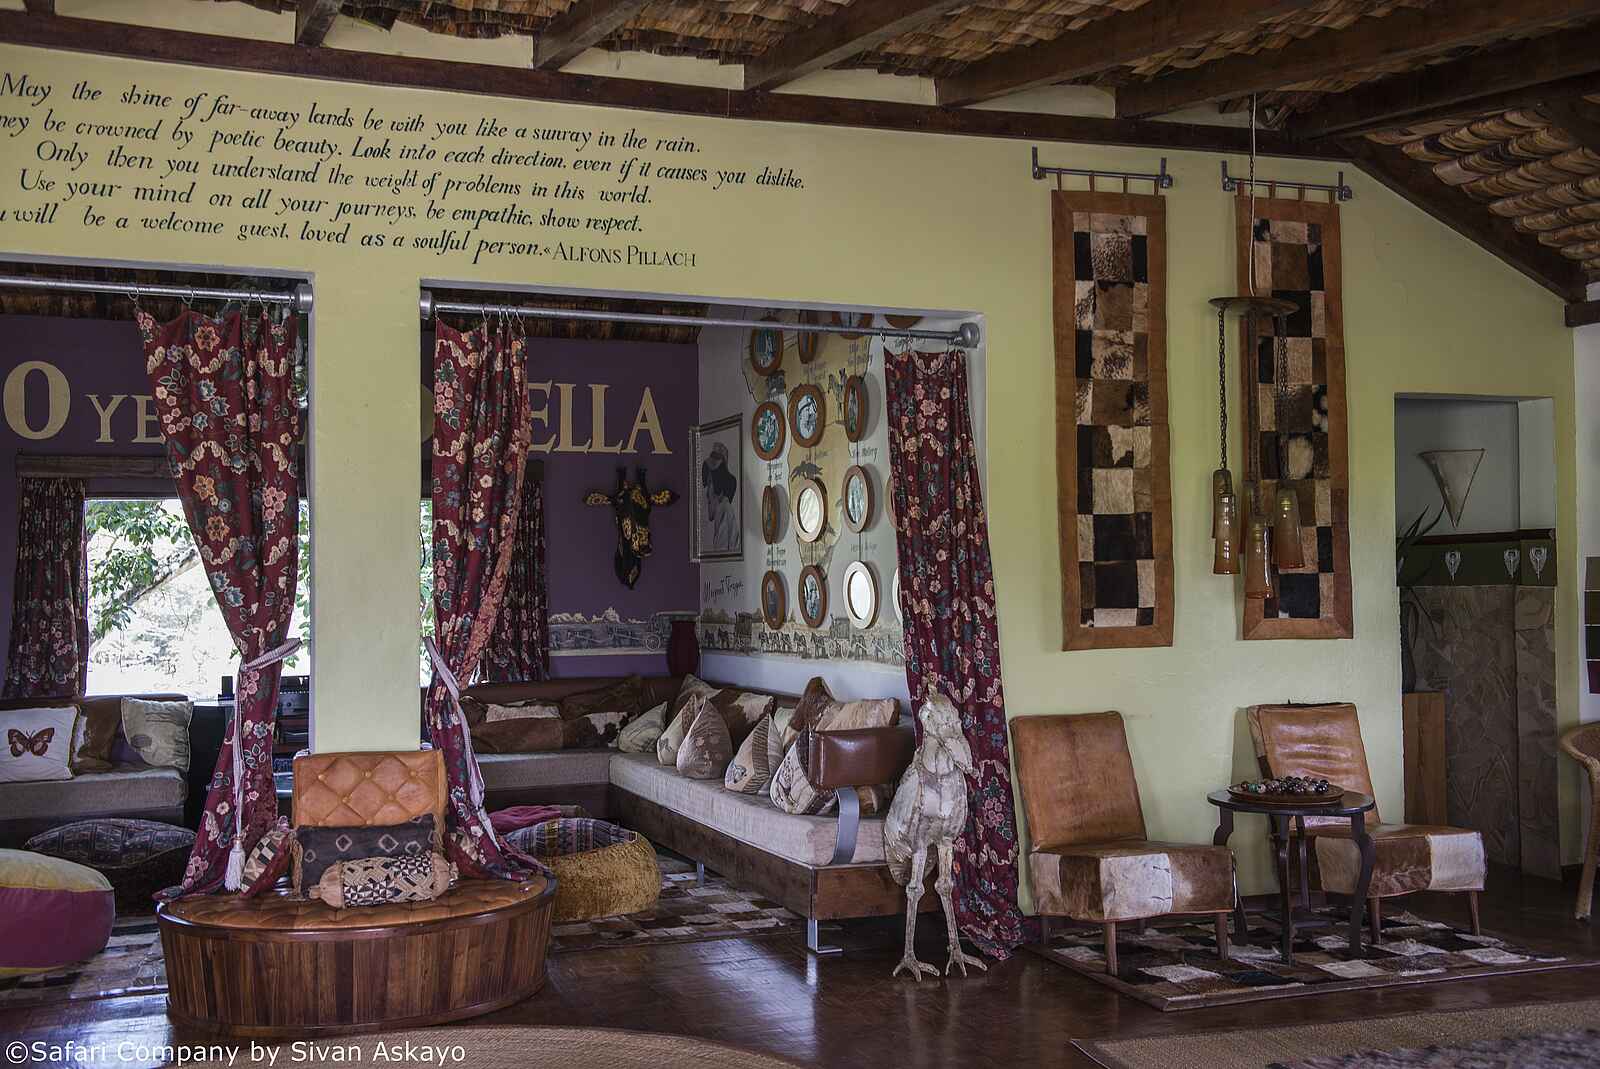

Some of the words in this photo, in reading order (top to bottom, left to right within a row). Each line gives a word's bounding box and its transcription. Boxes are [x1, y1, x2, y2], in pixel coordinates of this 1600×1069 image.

[0, 73, 51, 107] May
[72, 81, 102, 100] the
[121, 84, 172, 107] shine
[180, 92, 208, 120] of
[200, 95, 299, 129] far-away
[308, 102, 354, 128] lands
[364, 108, 383, 130] be
[390, 114, 424, 132] with
[431, 123, 467, 140] you
[475, 118, 507, 137] like
[515, 128, 527, 138] a
[533, 128, 592, 152] sunray
[598, 131, 615, 147] in
[622, 128, 647, 149] the
[656, 137, 700, 152] rain.
[37, 140, 88, 171] Only
[107, 145, 153, 169] then
[160, 160, 199, 179] you
[212, 156, 320, 183] understand
[329, 163, 354, 185] the
[365, 169, 418, 195] weight
[422, 171, 442, 195] of
[442, 174, 521, 200] problems
[532, 182, 547, 197] in
[554, 181, 584, 200] this
[600, 185, 651, 204] world.
[44, 108, 66, 132] be
[76, 120, 163, 140] crowned
[172, 120, 194, 150] by
[207, 130, 264, 153] poetic
[274, 128, 342, 162] beauty.
[352, 136, 391, 159] Look
[399, 144, 436, 160] into
[444, 145, 485, 163] each
[573, 160, 611, 171] even
[618, 157, 638, 183] if
[639, 162, 651, 177] it
[657, 167, 707, 181] causes
[713, 171, 746, 190] you
[756, 166, 804, 189] dislike.
[13, 203, 58, 224] will
[84, 205, 105, 226] be
[116, 217, 128, 228] a
[141, 211, 224, 234] welcome
[300, 220, 350, 244] loved
[361, 234, 386, 247] as
[393, 236, 404, 247] a
[412, 229, 471, 255] soulful
[552, 242, 621, 263] ALFONS
[627, 245, 695, 267] PILLACH
[21, 168, 55, 191] Use
[62, 183, 122, 201] your
[134, 182, 196, 203] mind
[209, 194, 232, 207] on
[242, 189, 272, 208] all
[275, 197, 328, 215] your
[427, 199, 445, 220] be
[540, 208, 580, 228] show
[586, 215, 642, 235] respect.
